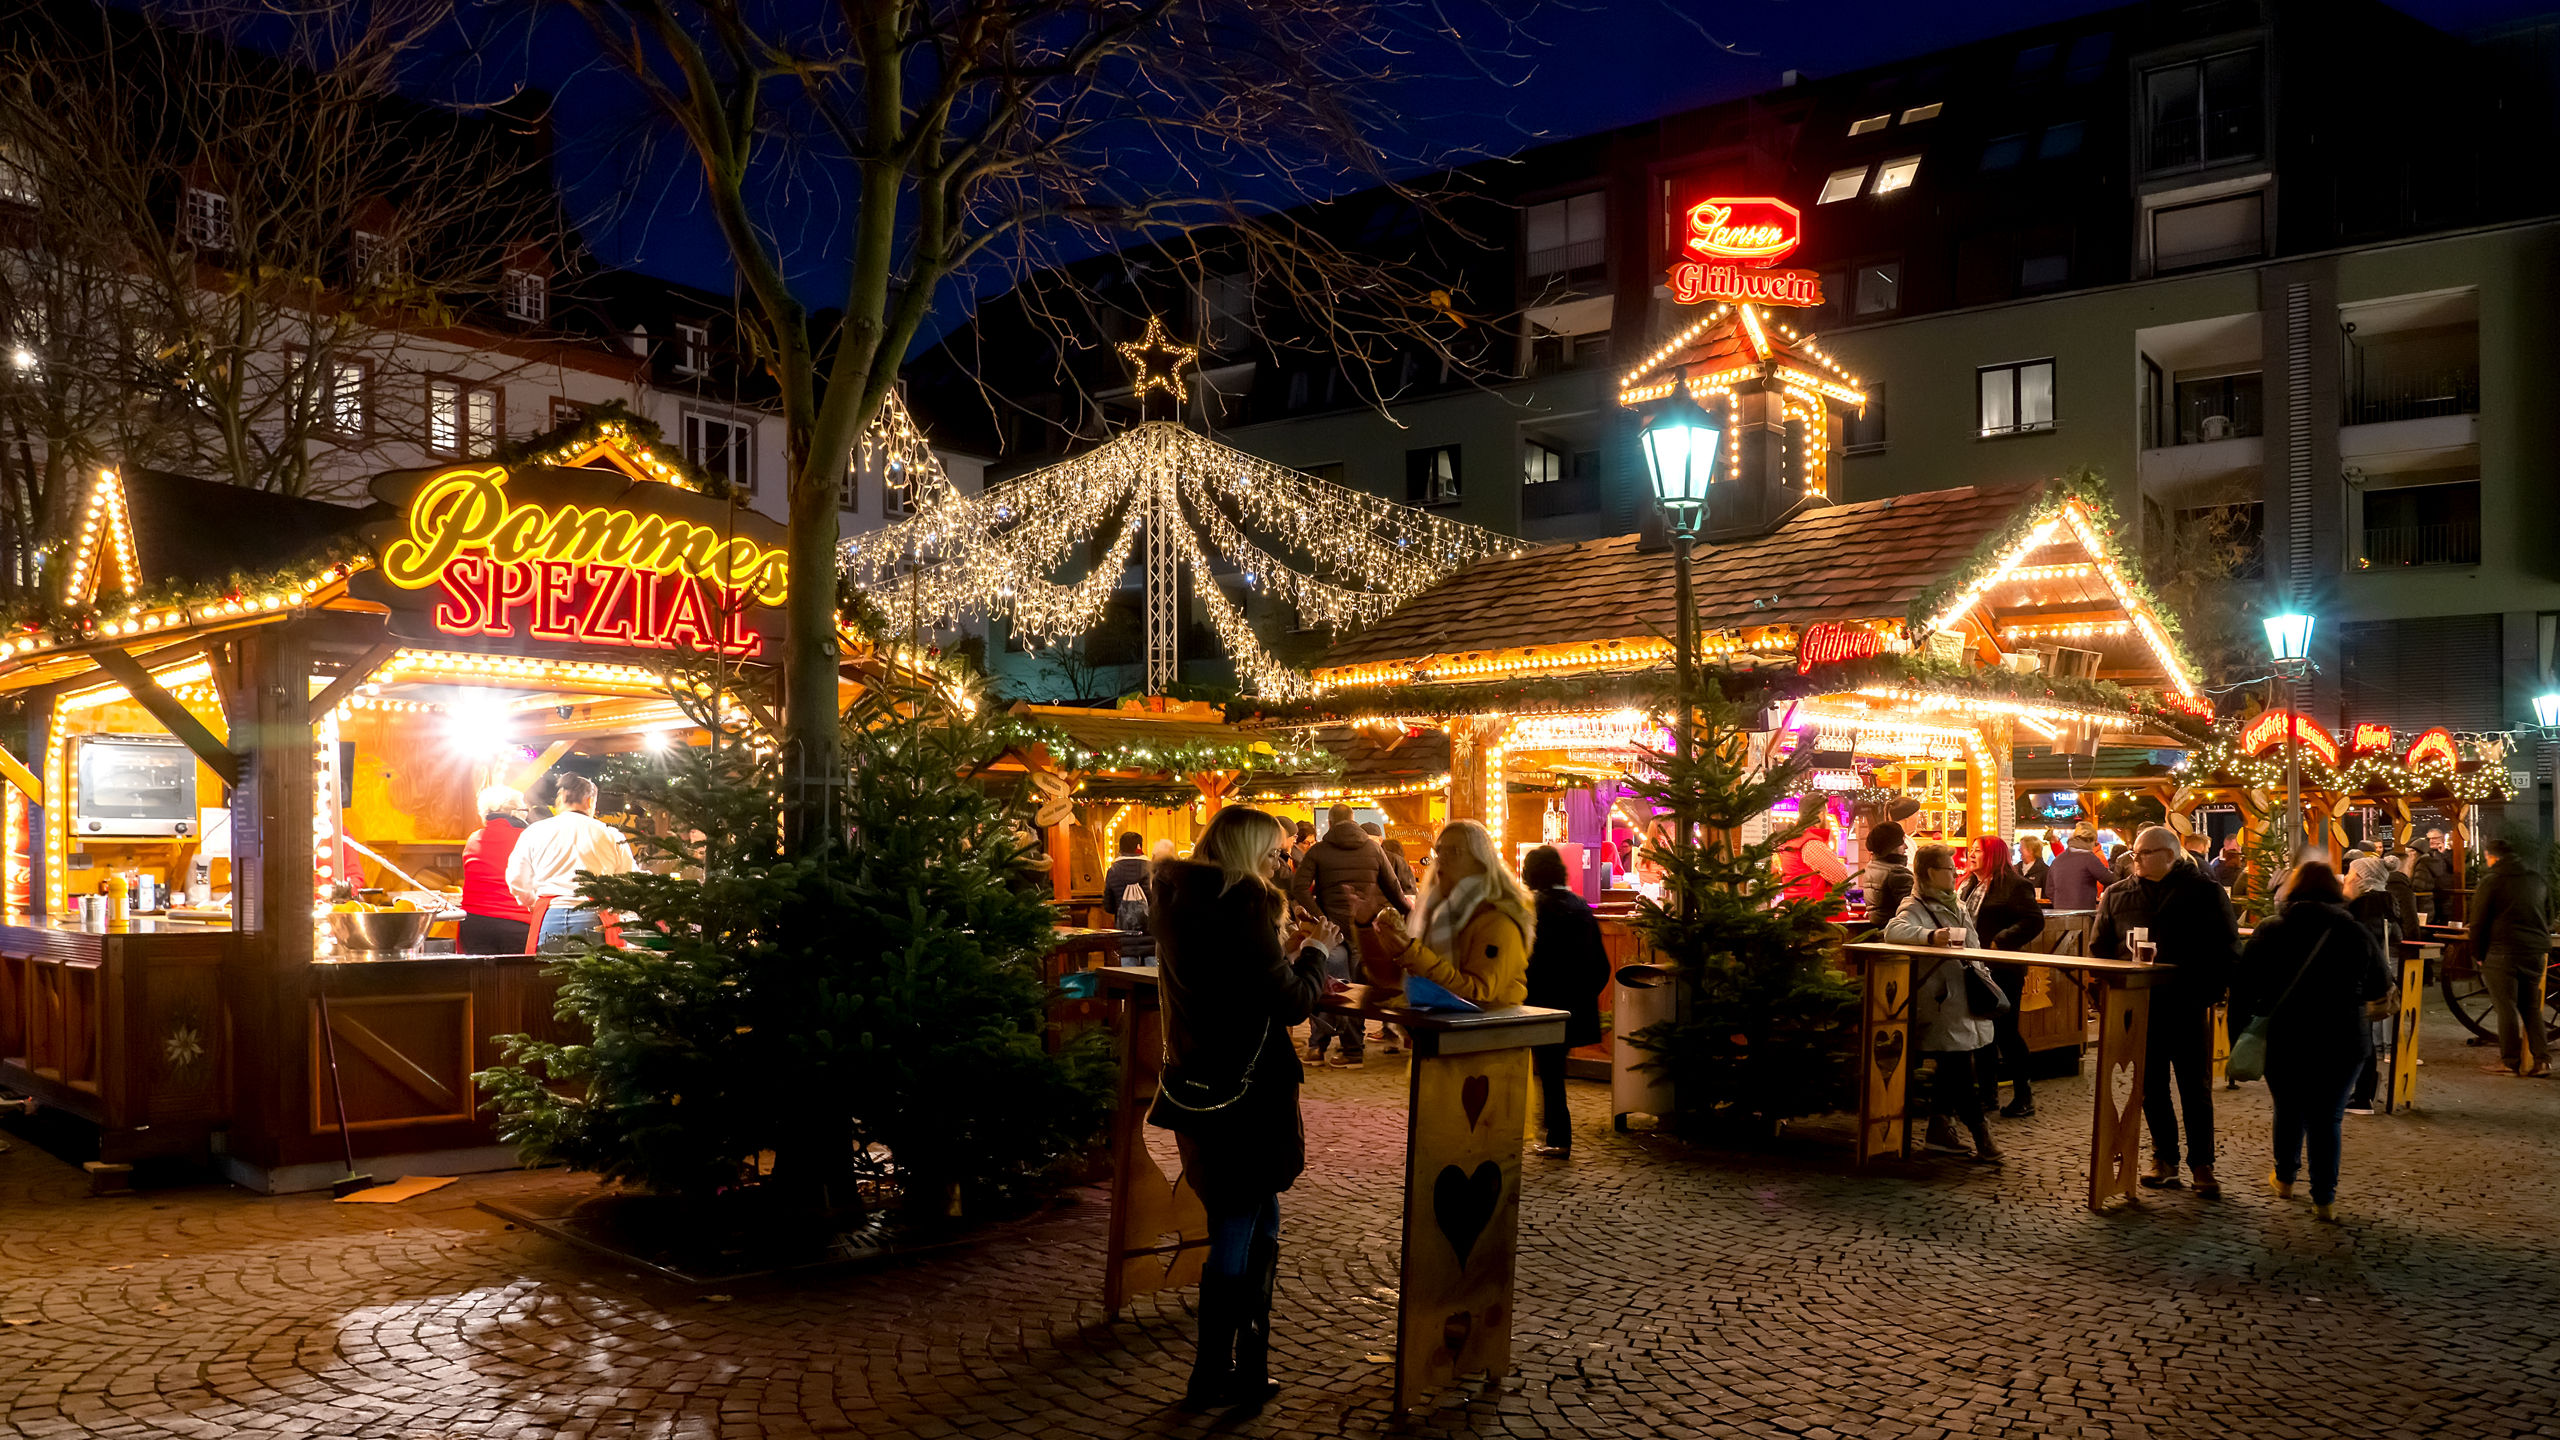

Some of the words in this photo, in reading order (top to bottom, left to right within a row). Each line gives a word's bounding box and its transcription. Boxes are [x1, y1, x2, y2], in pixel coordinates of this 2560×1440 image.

[1690, 204, 1790, 254] Lansen
[1676, 262, 1816, 303] Glühwein
[383, 466, 790, 606] Pommes
[436, 553, 763, 658] SPEZIAL
[1797, 620, 1882, 674] Glühwein
